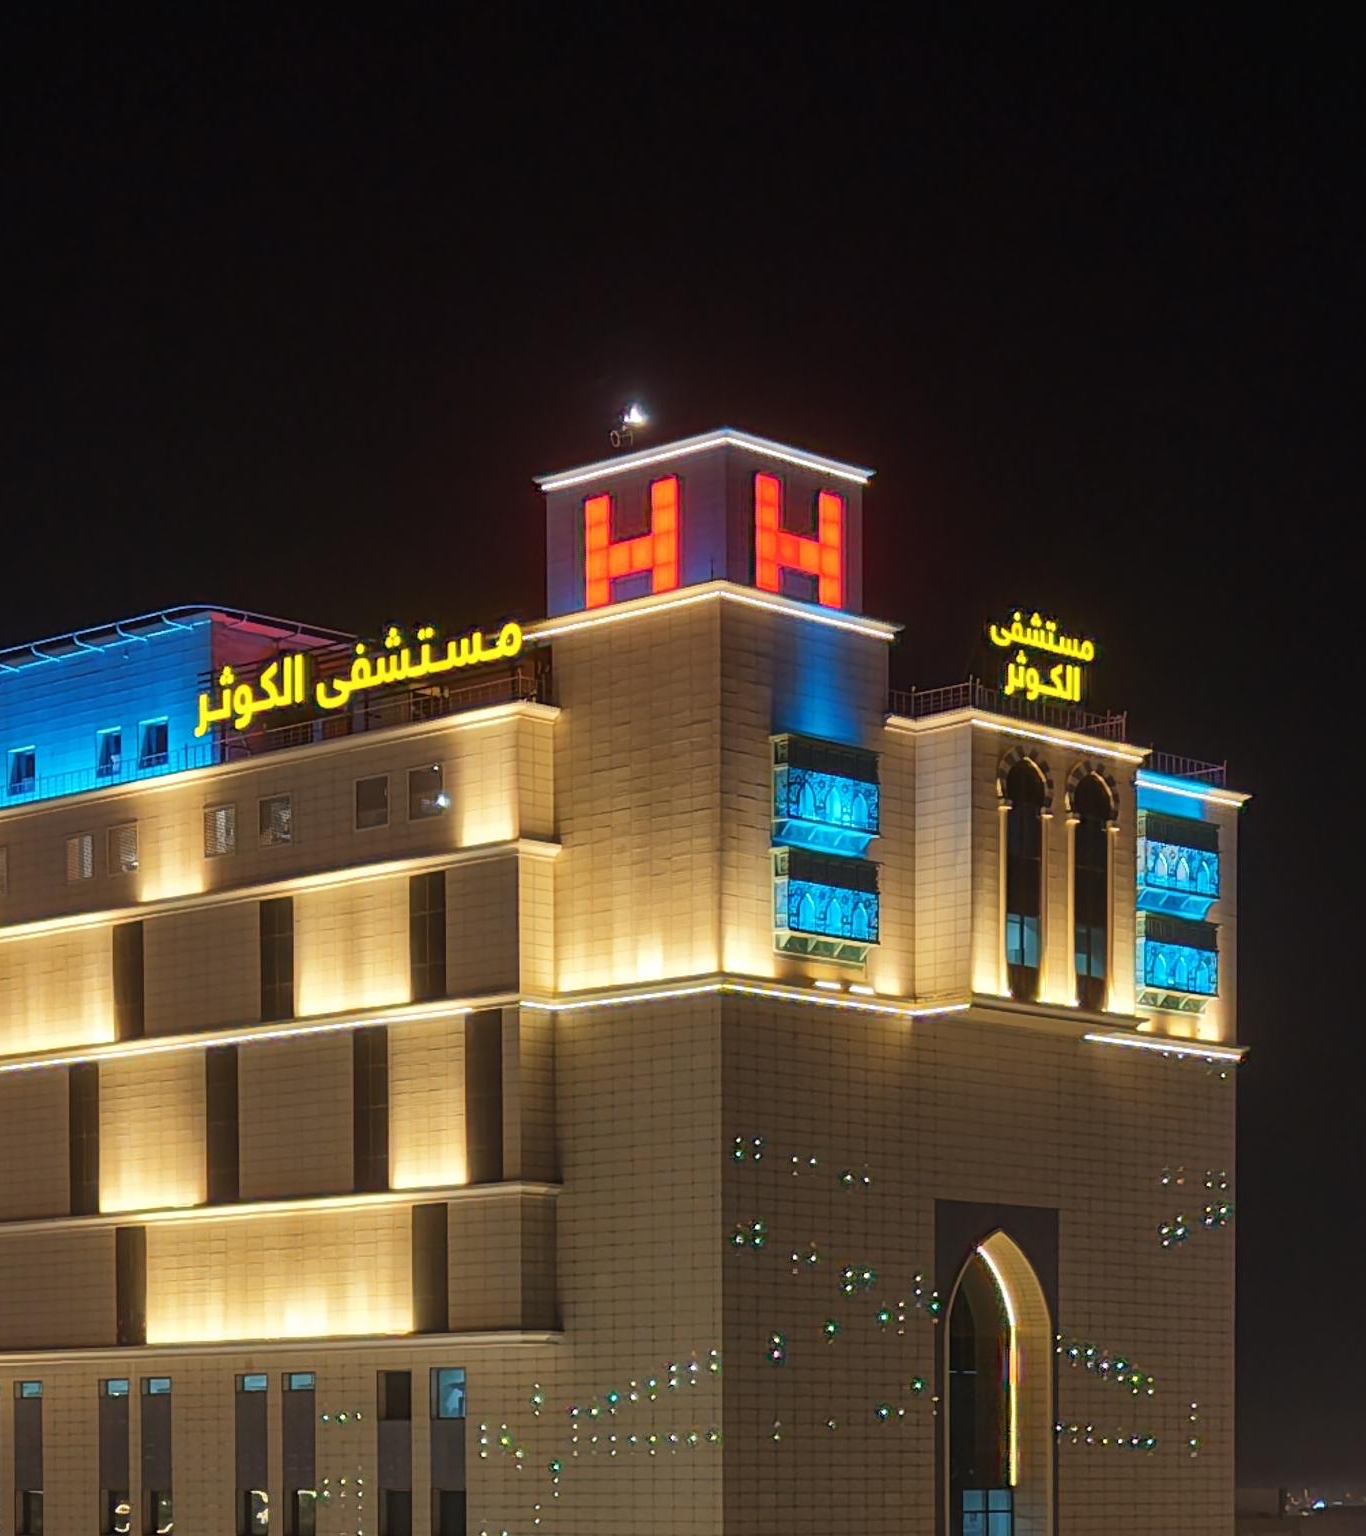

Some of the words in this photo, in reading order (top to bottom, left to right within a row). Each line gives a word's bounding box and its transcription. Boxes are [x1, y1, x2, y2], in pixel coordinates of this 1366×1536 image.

[584, 473, 679, 609] H
[754, 471, 843, 608] H
[315, 620, 524, 710] مستشفى
[989, 611, 1095, 662] مستشفى
[1004, 649, 1081, 702] الكوثر
[193, 653, 307, 738] الكوثر
